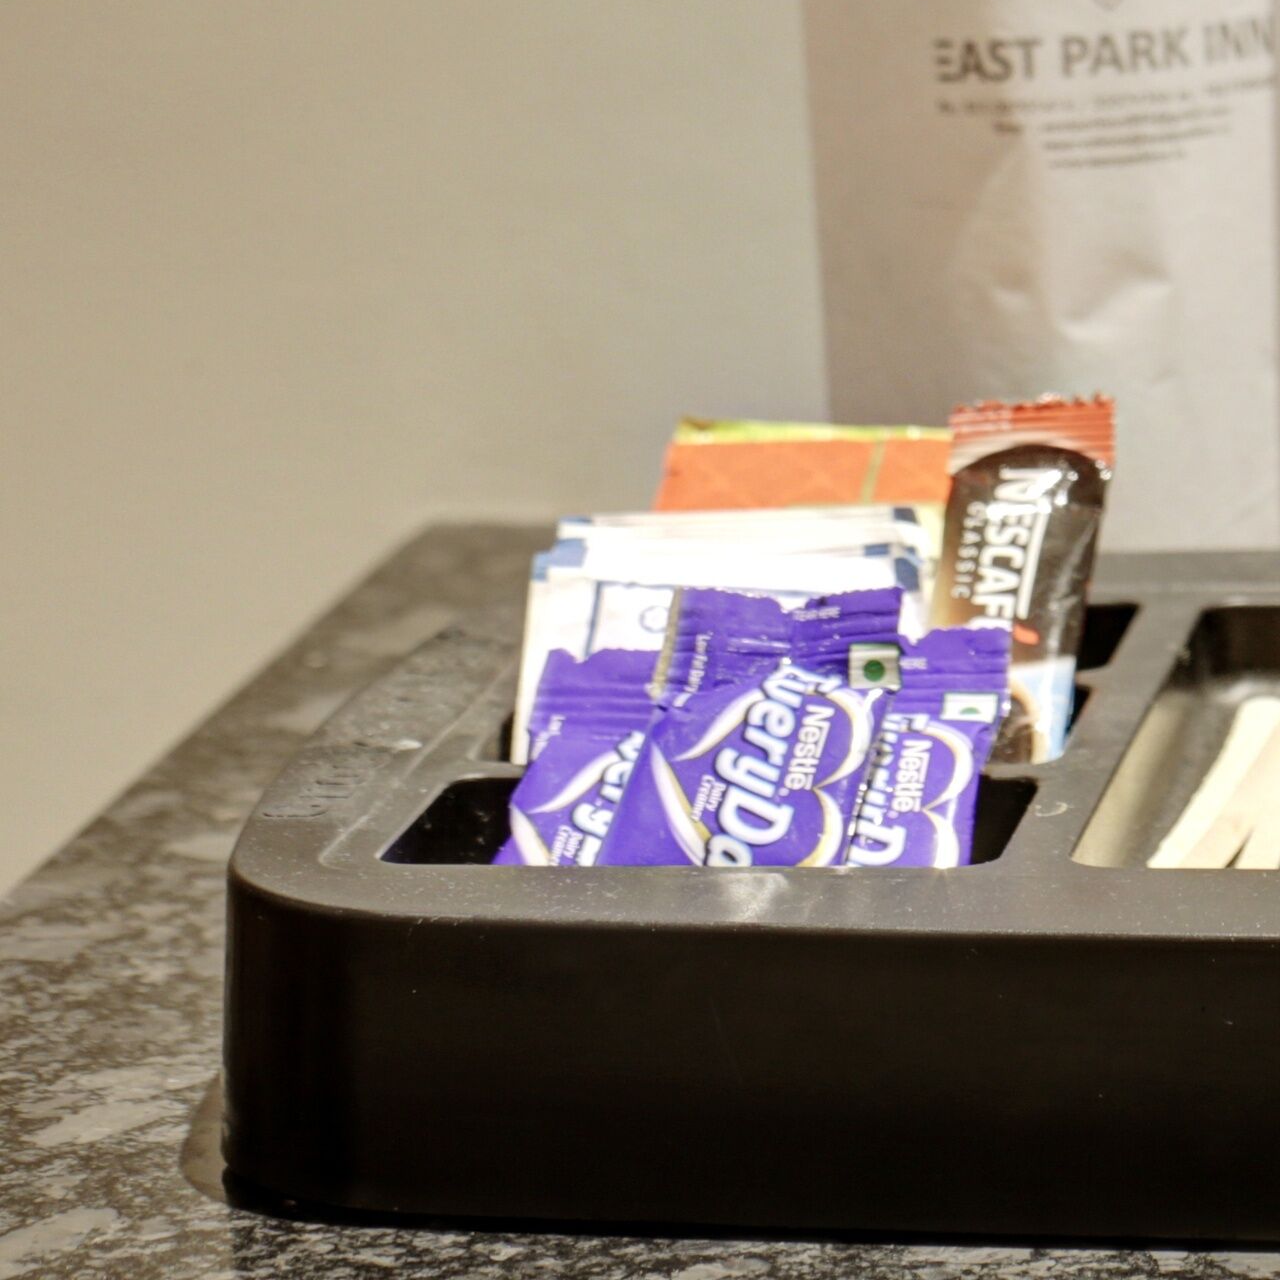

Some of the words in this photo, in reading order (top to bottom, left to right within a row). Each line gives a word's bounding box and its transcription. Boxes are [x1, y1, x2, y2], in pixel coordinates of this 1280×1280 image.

[932, 36, 1042, 84] EAST
[1060, 26, 1191, 77] PARK
[1203, 17, 1276, 67] INN
[951, 501, 987, 599] CLASSIC
[969, 465, 1063, 632] NESCAF
